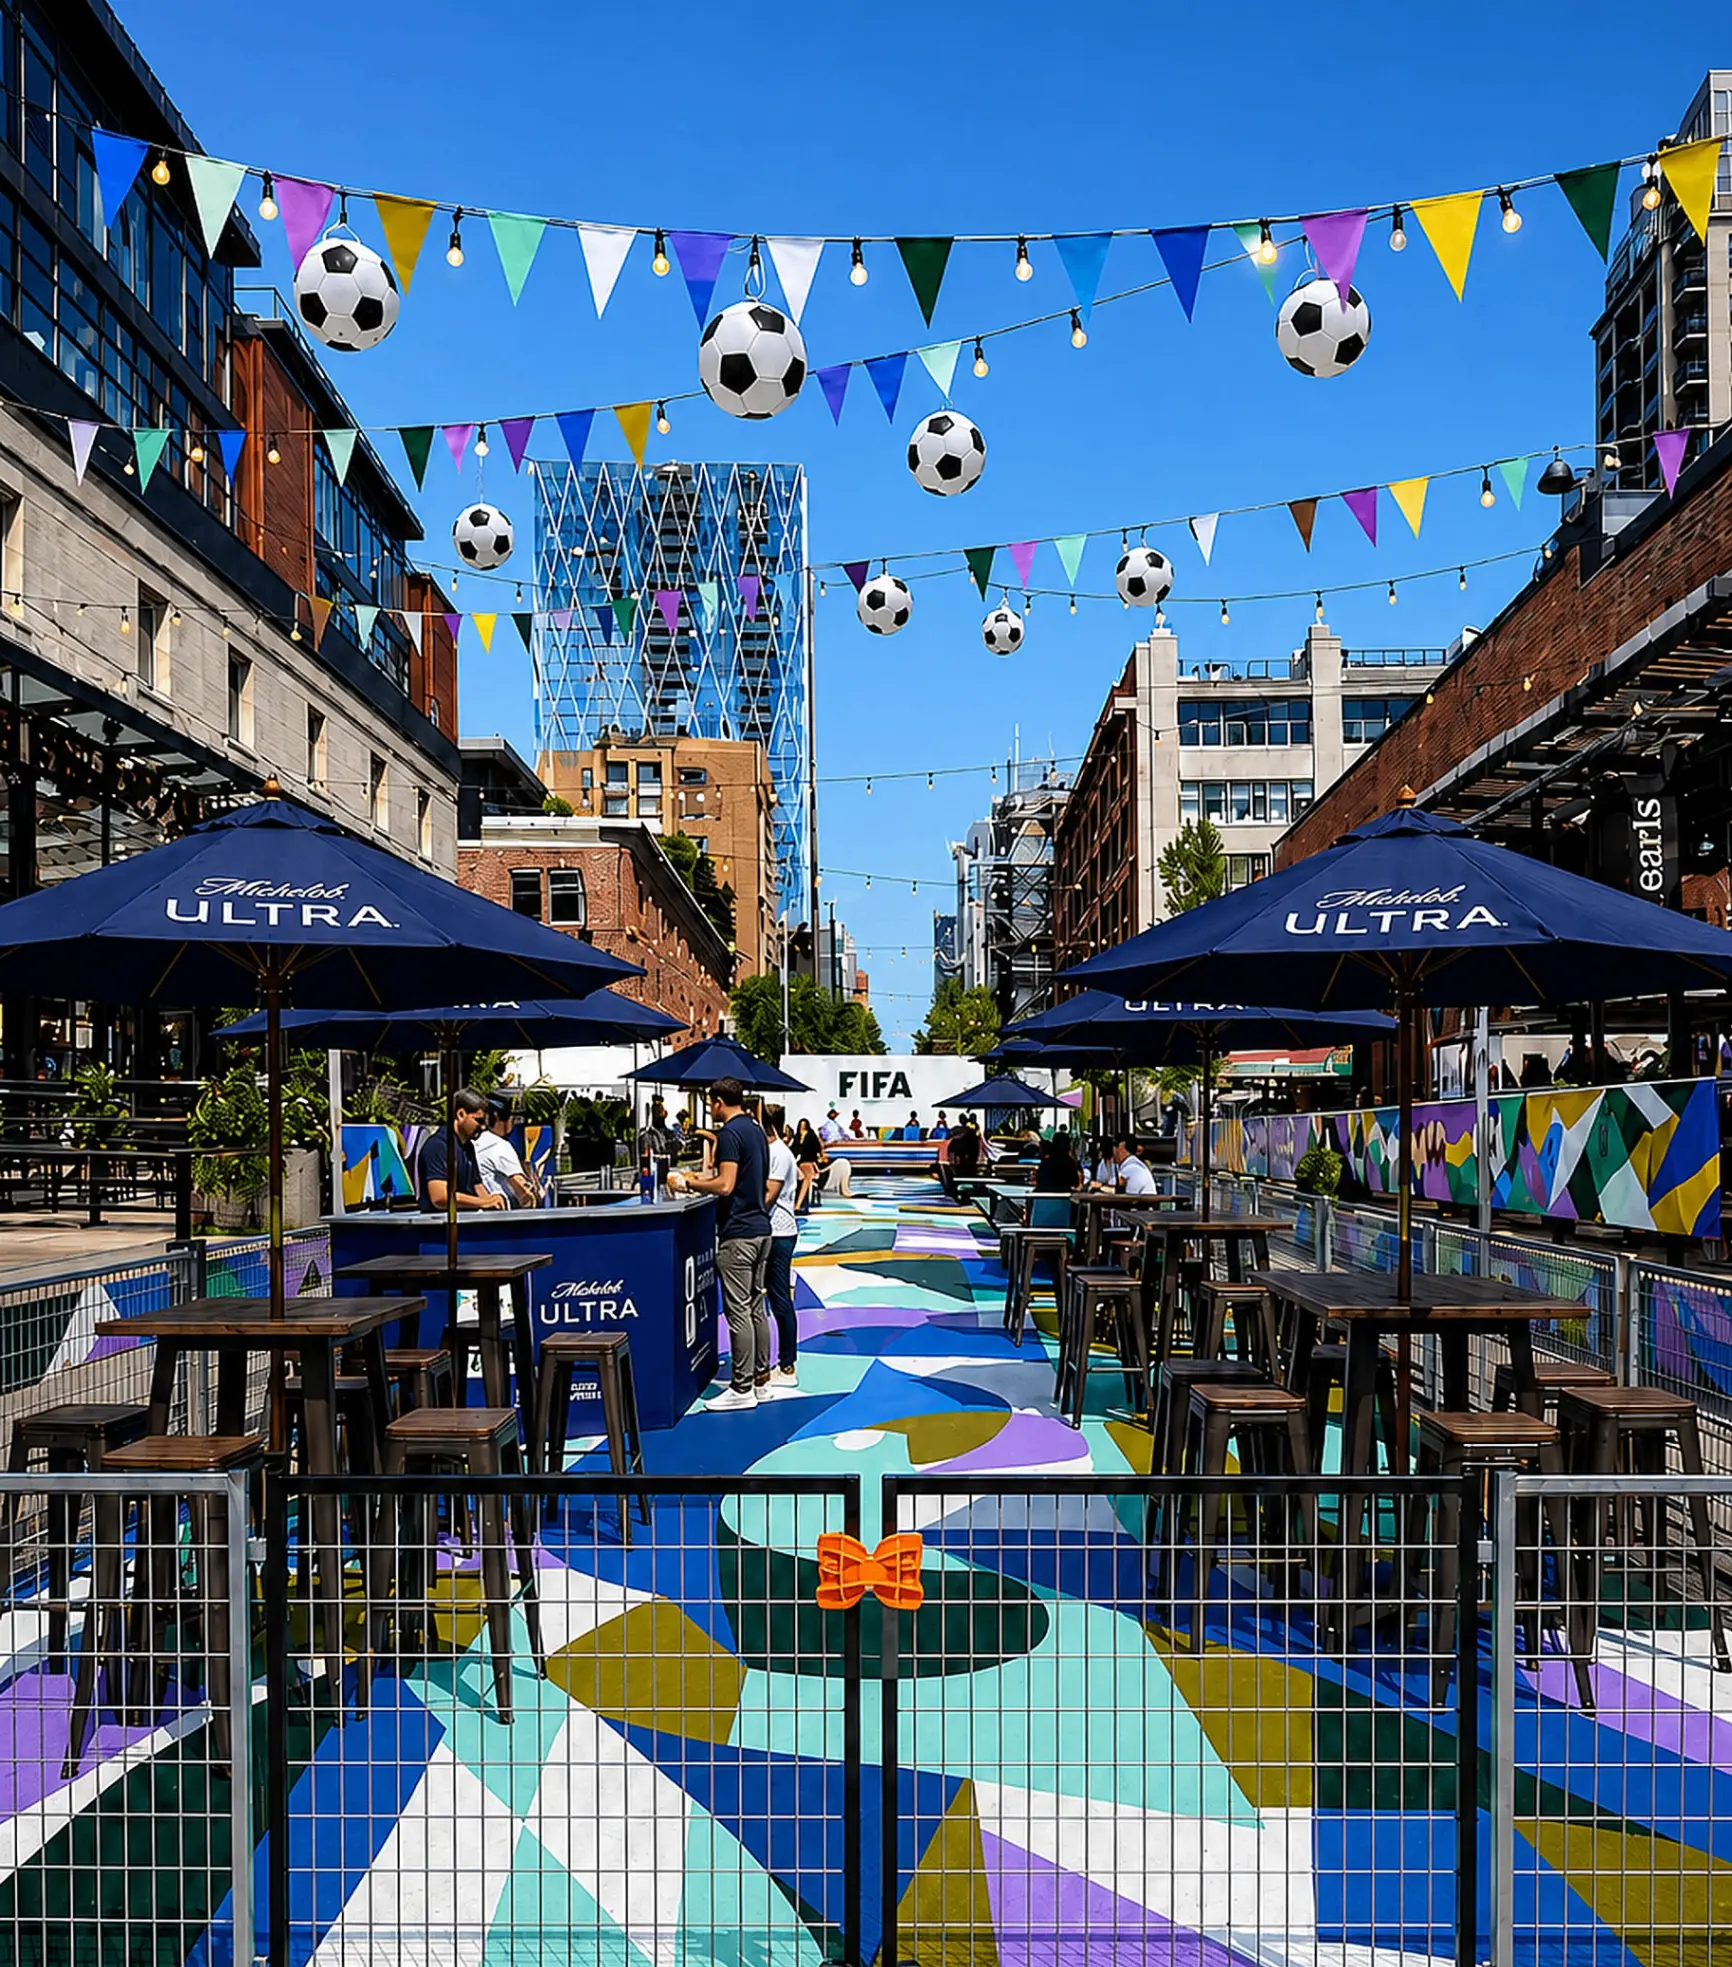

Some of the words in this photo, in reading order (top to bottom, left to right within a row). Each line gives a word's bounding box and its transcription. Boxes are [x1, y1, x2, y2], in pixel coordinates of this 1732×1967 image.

[1633, 799, 1663, 891] earls
[195, 877, 350, 900] Michelob
[1316, 884, 1466, 908] Michelob
[166, 899, 401, 927] ULTRA
[1285, 906, 1509, 934] ULTRA
[839, 1071, 912, 1098] FIFA
[540, 1298, 639, 1325] ULTRA
